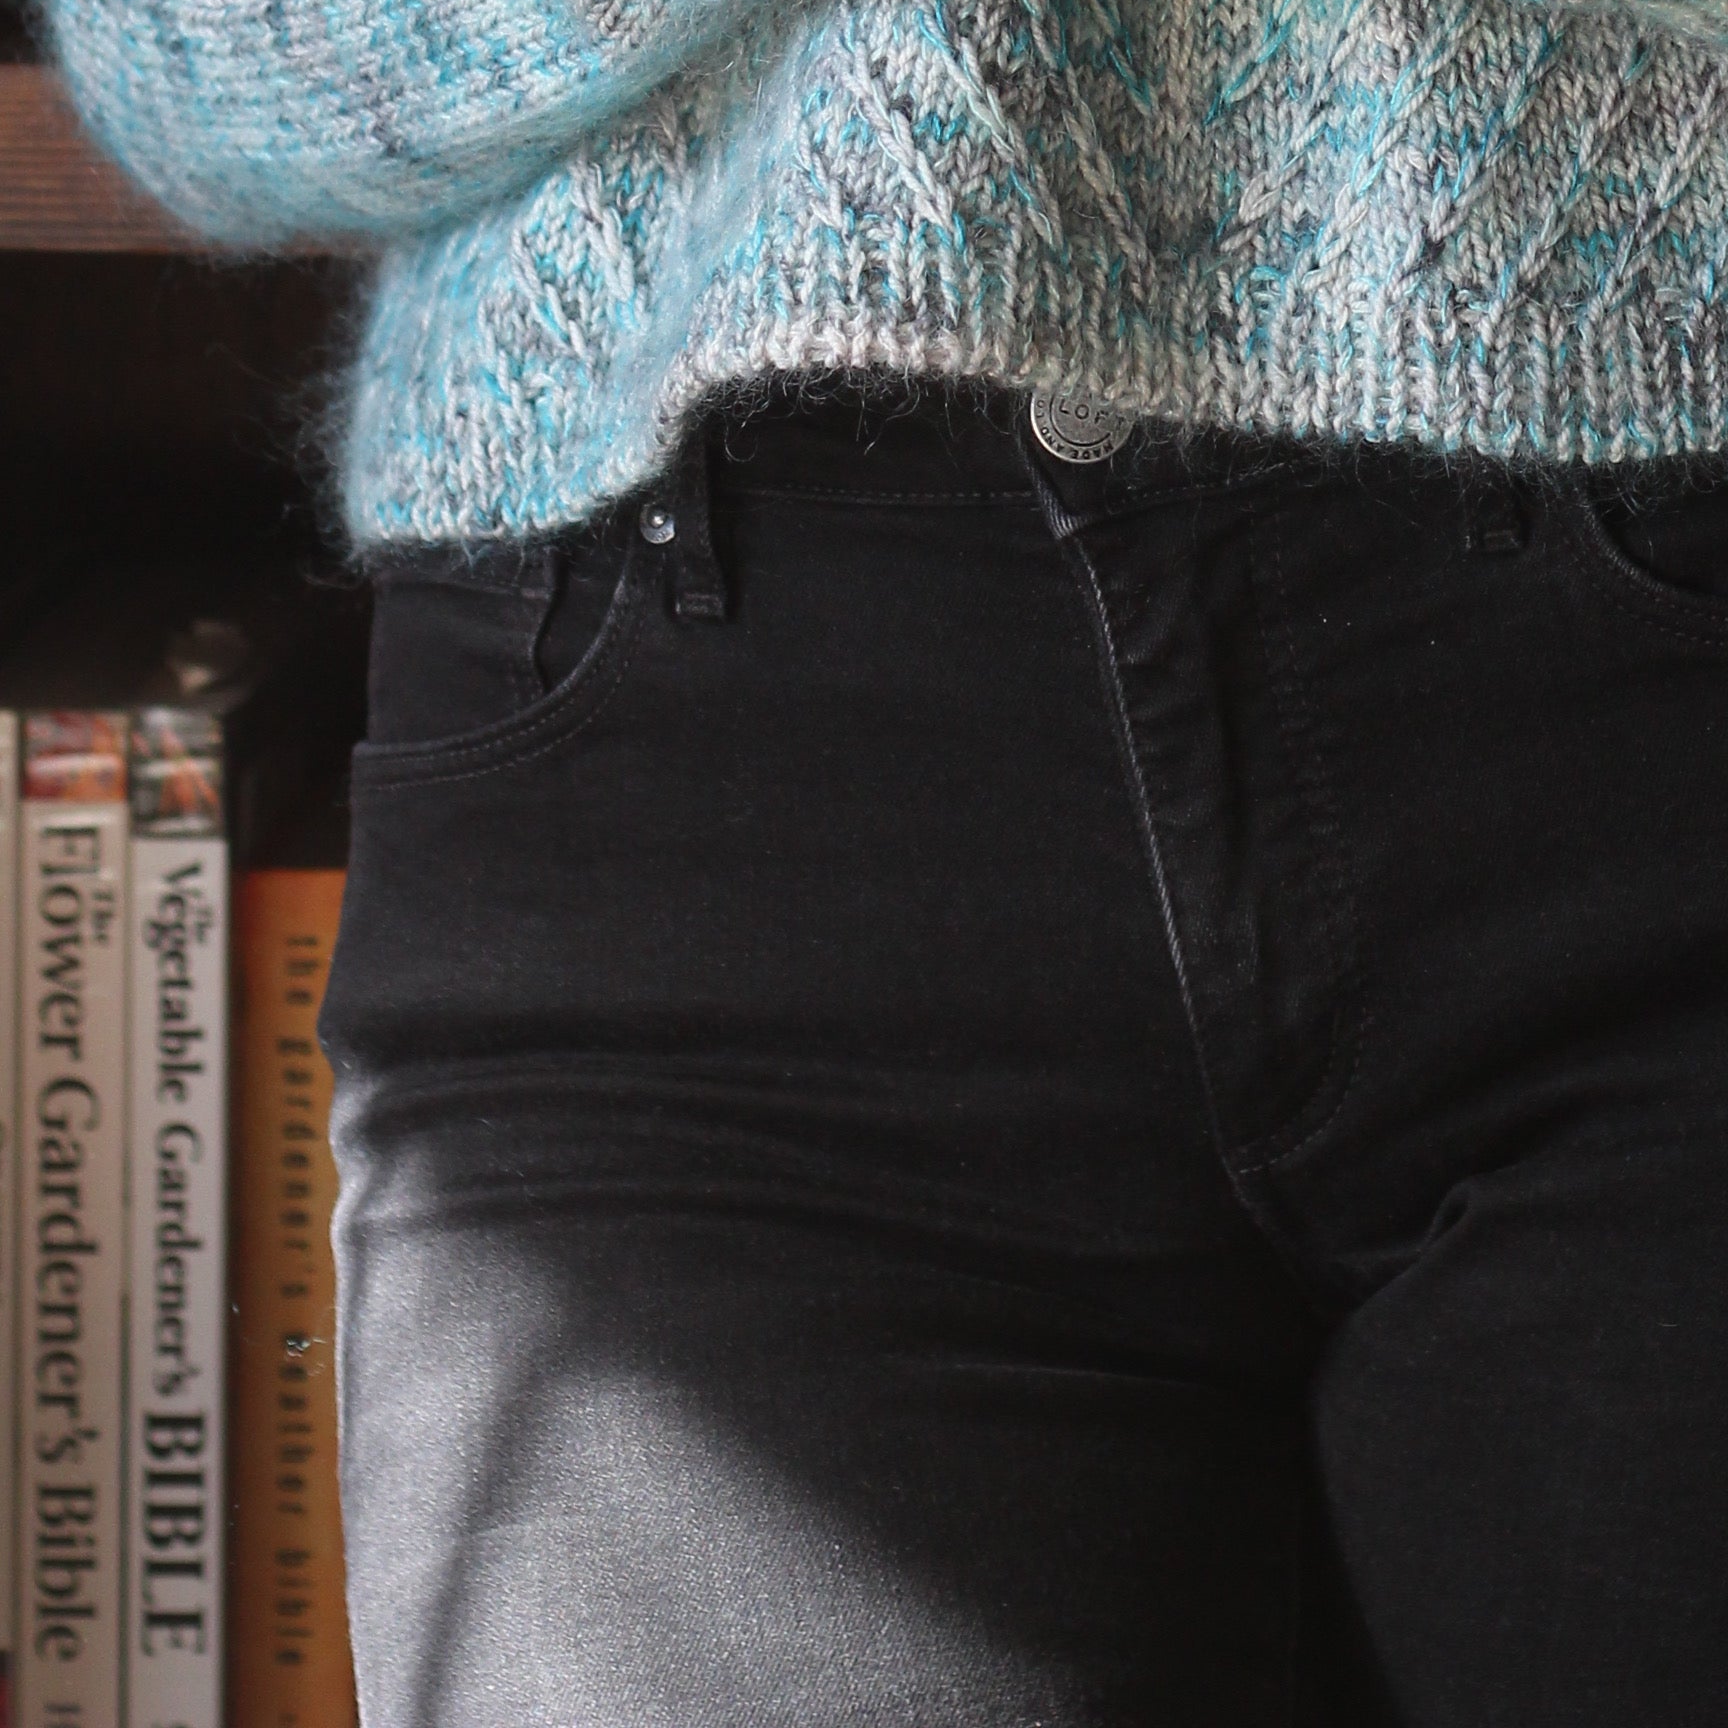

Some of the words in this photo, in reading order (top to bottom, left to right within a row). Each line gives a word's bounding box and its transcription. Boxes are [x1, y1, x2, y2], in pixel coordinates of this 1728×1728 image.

[1040, 426, 1065, 453] AND
[1069, 439, 1115, 460] MADE
[35, 823, 103, 1062] Flower
[147, 860, 209, 1103] Vegetable
[283, 935, 320, 1006] the
[35, 1077, 101, 1464] Gardener's
[154, 1122, 204, 1397] Gardener's
[276, 1036, 319, 1300] gardener's
[31, 1482, 97, 1662] Bible
[139, 1409, 208, 1657] BIBLE
[274, 1548, 316, 1668] bible
